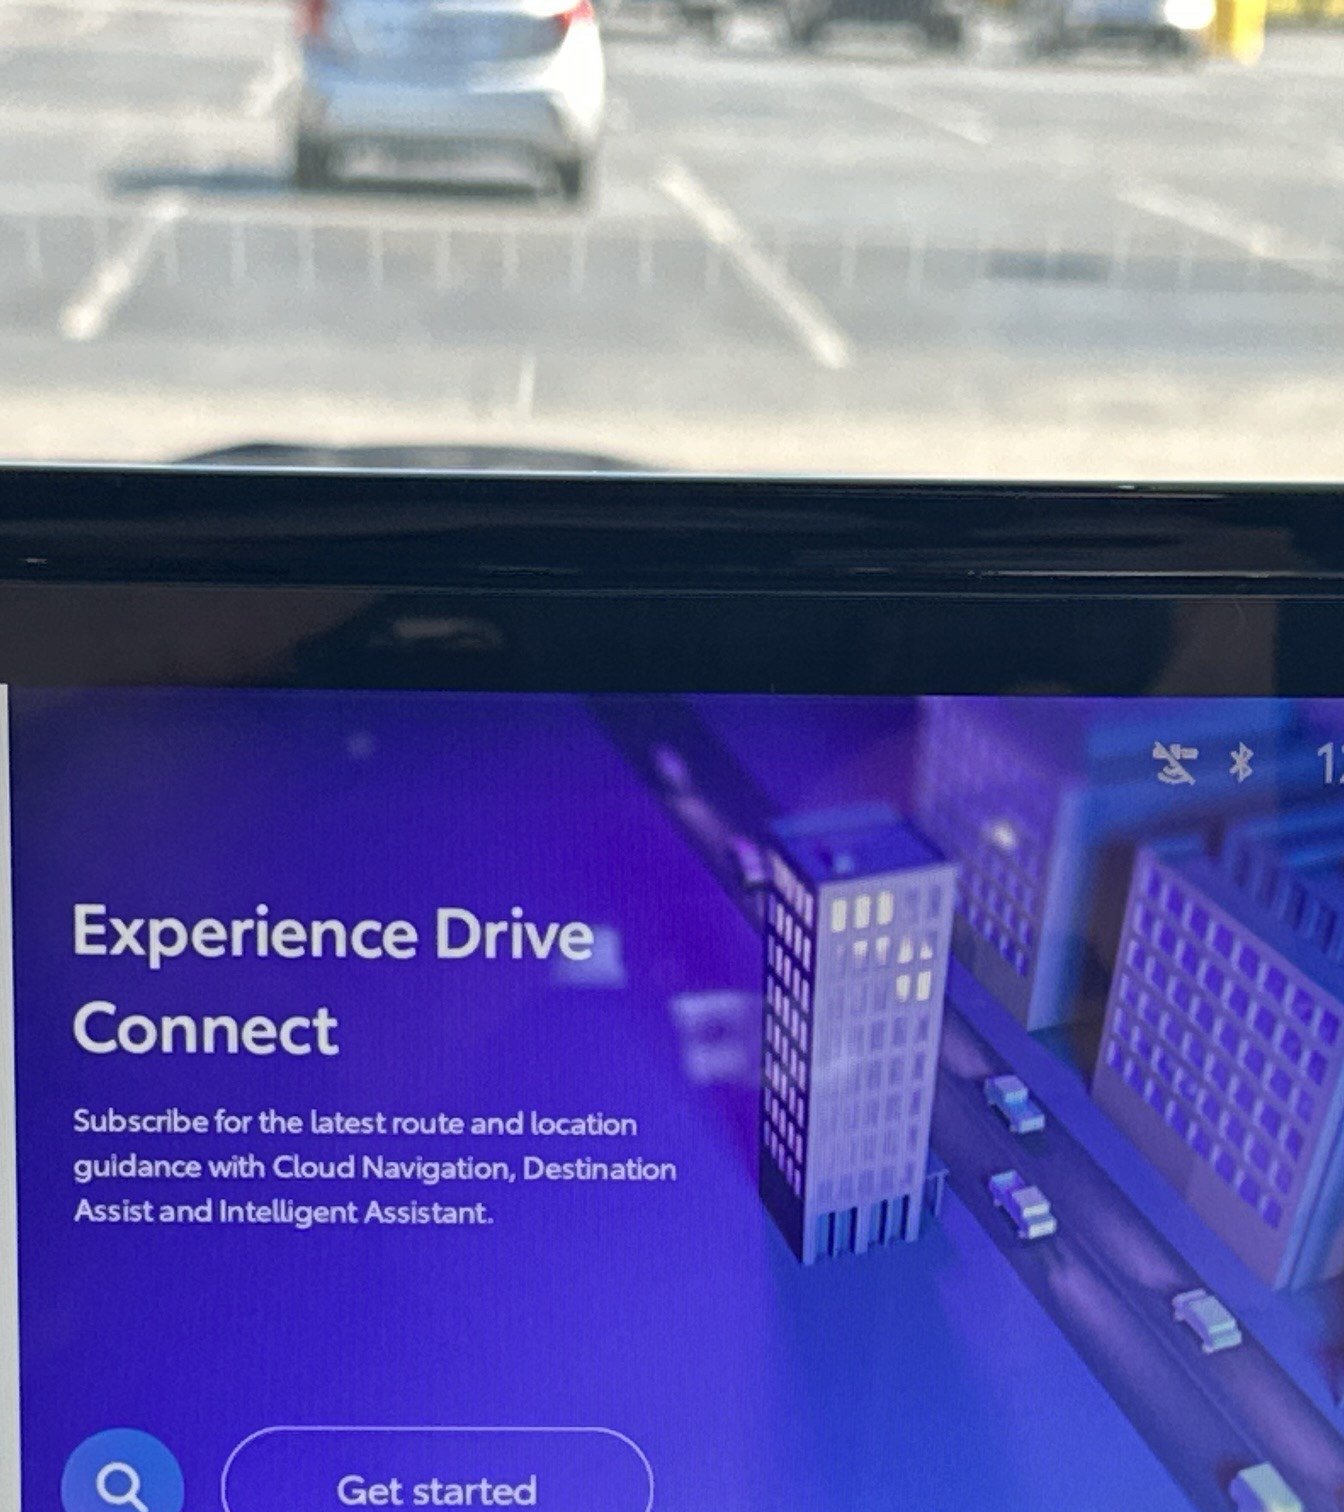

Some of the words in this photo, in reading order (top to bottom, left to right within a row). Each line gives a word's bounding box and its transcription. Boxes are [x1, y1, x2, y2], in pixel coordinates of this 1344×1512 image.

[73, 903, 418, 969] Experience
[435, 906, 595, 960] Drive
[73, 1001, 339, 1056] Connect
[73, 1108, 209, 1134] Subscribe
[214, 1109, 252, 1134] for
[258, 1109, 304, 1135] the
[310, 1110, 387, 1135] latest
[392, 1112, 465, 1136] route
[471, 1111, 524, 1136] and
[530, 1111, 637, 1138] location
[73, 1153, 202, 1185] guidance
[208, 1154, 265, 1179] with
[272, 1154, 355, 1181] Cloud
[362, 1155, 517, 1185] Navigation,
[524, 1156, 677, 1182] Destination
[73, 1198, 154, 1224] Assist
[159, 1199, 213, 1224] and
[219, 1199, 358, 1230] Intelligent
[364, 1200, 494, 1226] Assistant.
[337, 1475, 404, 1506] Get
[413, 1475, 537, 1507] started
